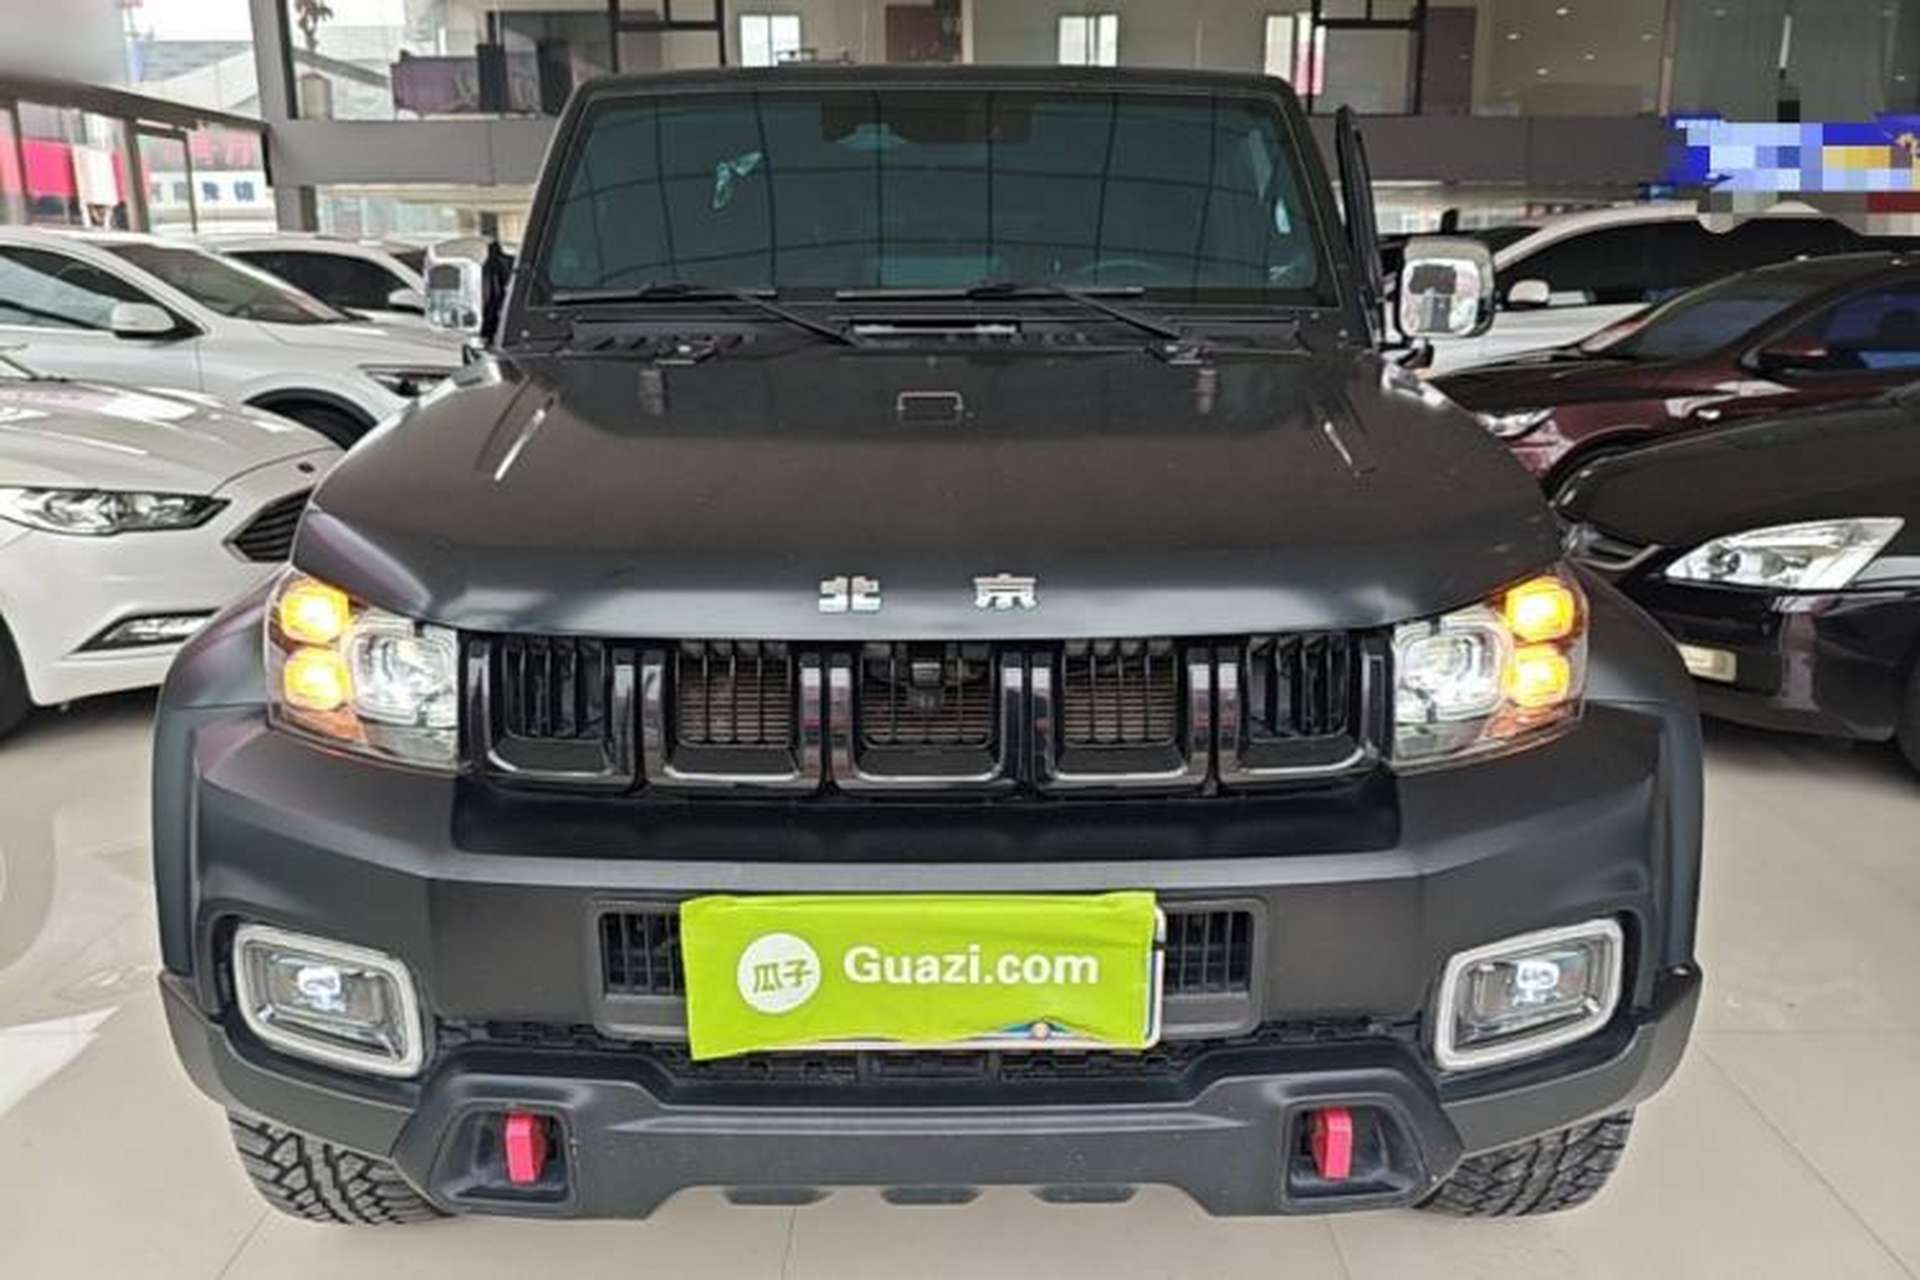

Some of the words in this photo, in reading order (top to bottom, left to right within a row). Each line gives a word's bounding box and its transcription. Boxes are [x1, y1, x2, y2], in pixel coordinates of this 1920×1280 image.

[818, 573, 1036, 613] 北京
[753, 959, 812, 993] 瓜子
[843, 944, 1099, 985] Guazi.com
